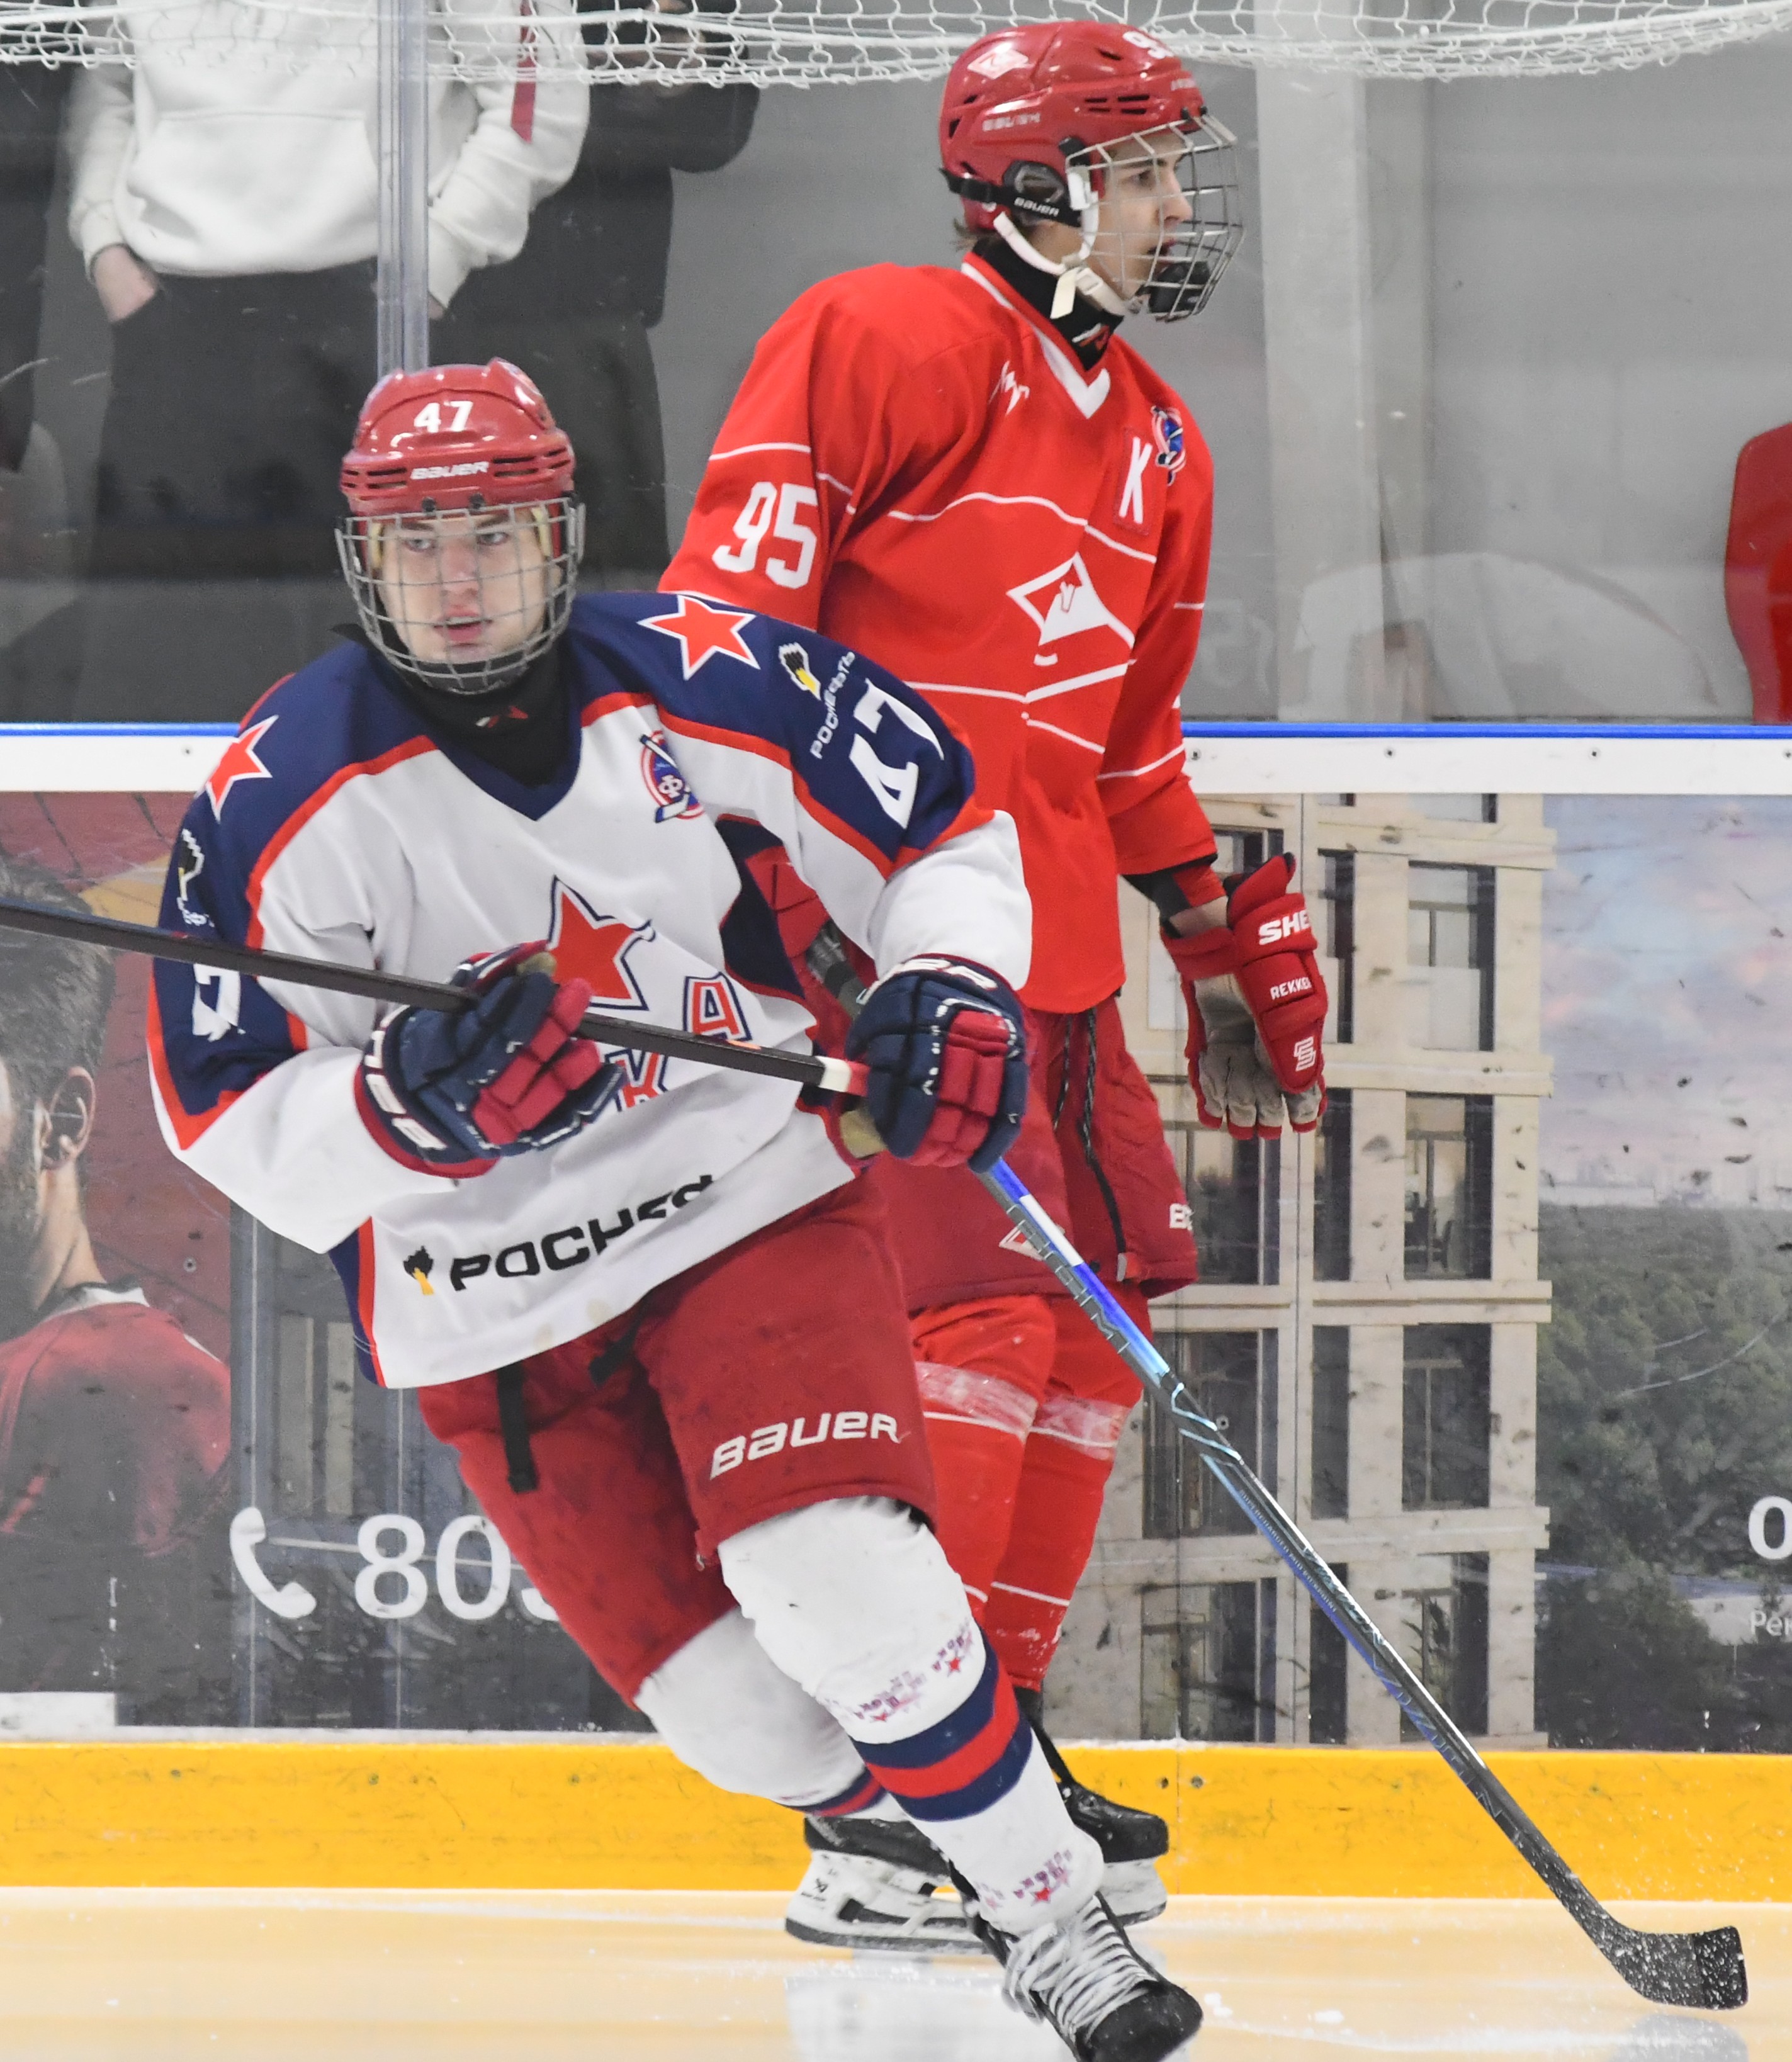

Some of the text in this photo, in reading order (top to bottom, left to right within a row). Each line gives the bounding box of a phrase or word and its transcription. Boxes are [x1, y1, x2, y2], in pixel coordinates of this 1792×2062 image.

[1014, 196, 1060, 217] BAUER
[414, 400, 474, 433] 47
[410, 461, 490, 480] BAUER
[712, 482, 819, 589] 95
[849, 678, 945, 830] 47
[709, 1411, 901, 1480] BAUER
